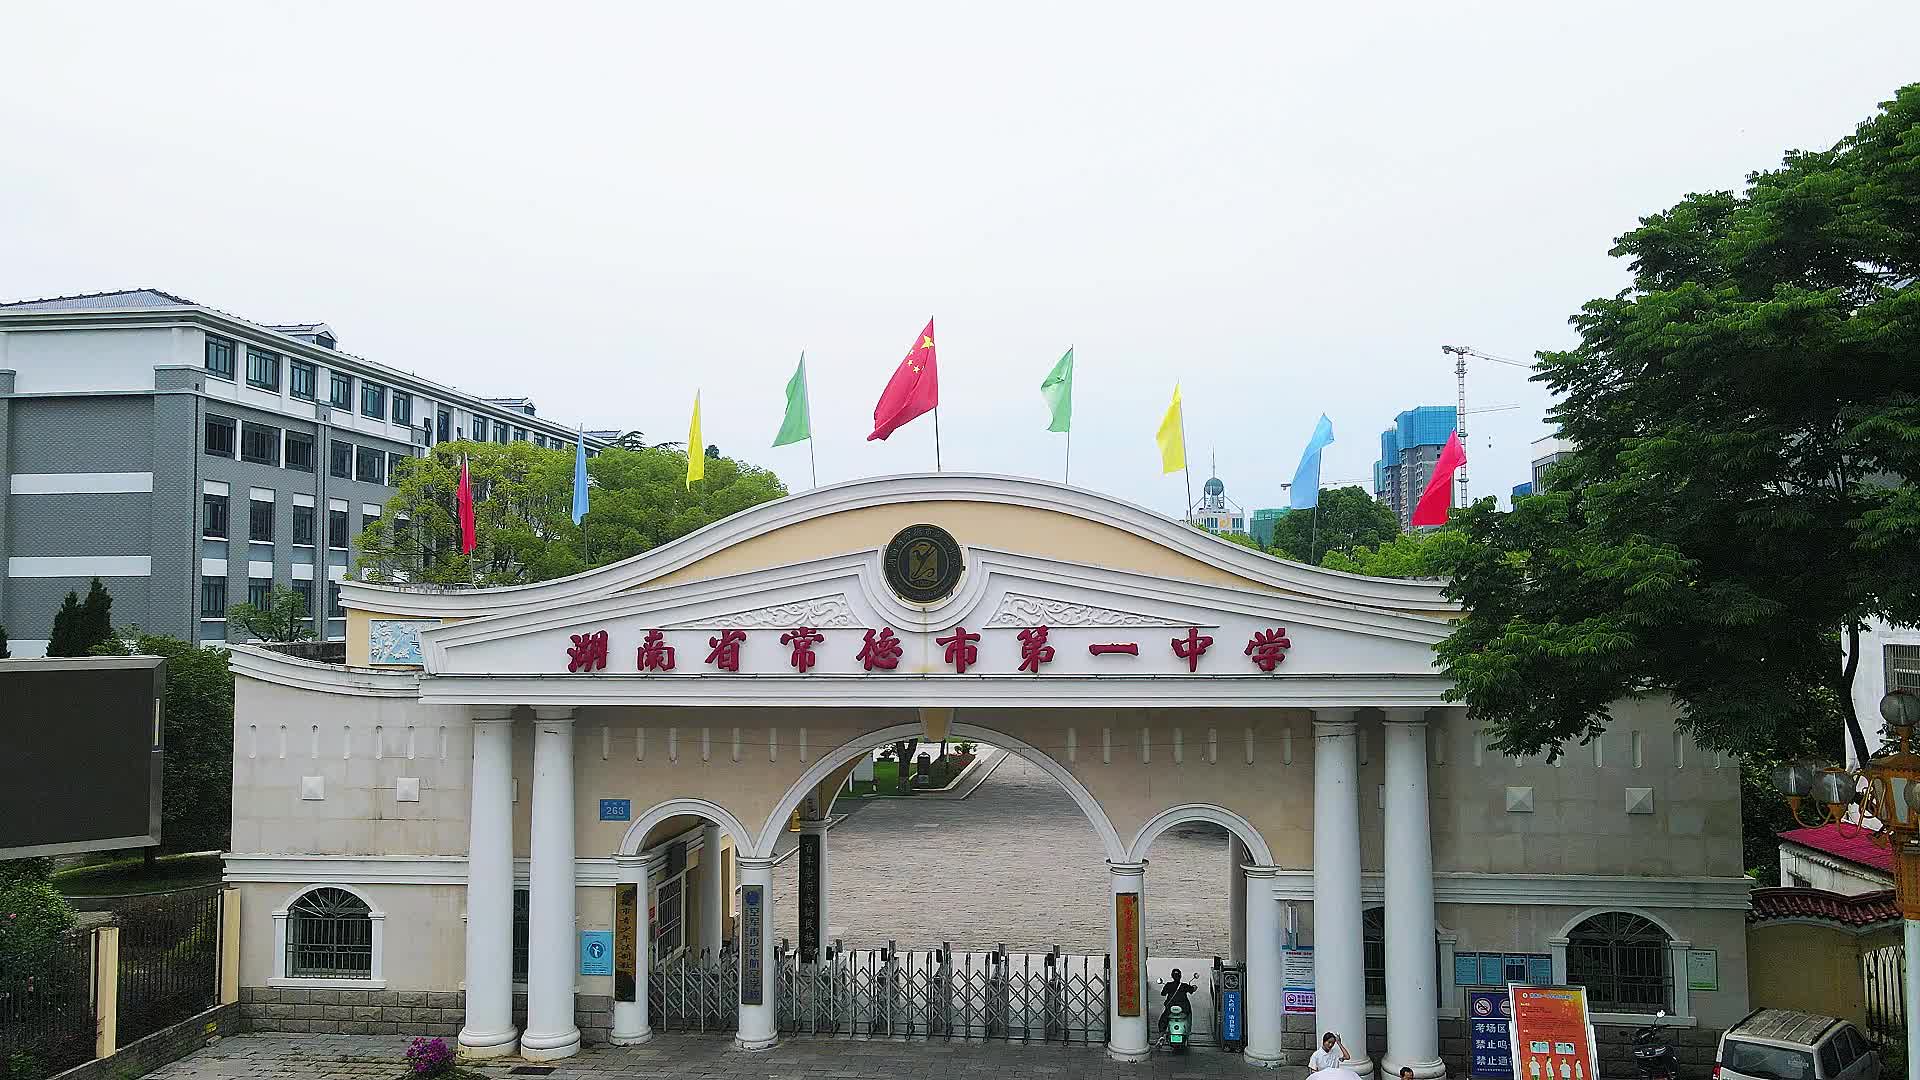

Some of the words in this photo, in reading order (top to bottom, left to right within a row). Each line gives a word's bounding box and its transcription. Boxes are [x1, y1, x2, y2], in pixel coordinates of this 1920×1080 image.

[569, 625, 1290, 673] 湖南省常德市第一中学
[606, 806, 624, 815] 263
[1475, 1023, 1510, 1034] 考场区
[1476, 1040, 1511, 1050] 禁止鸣
